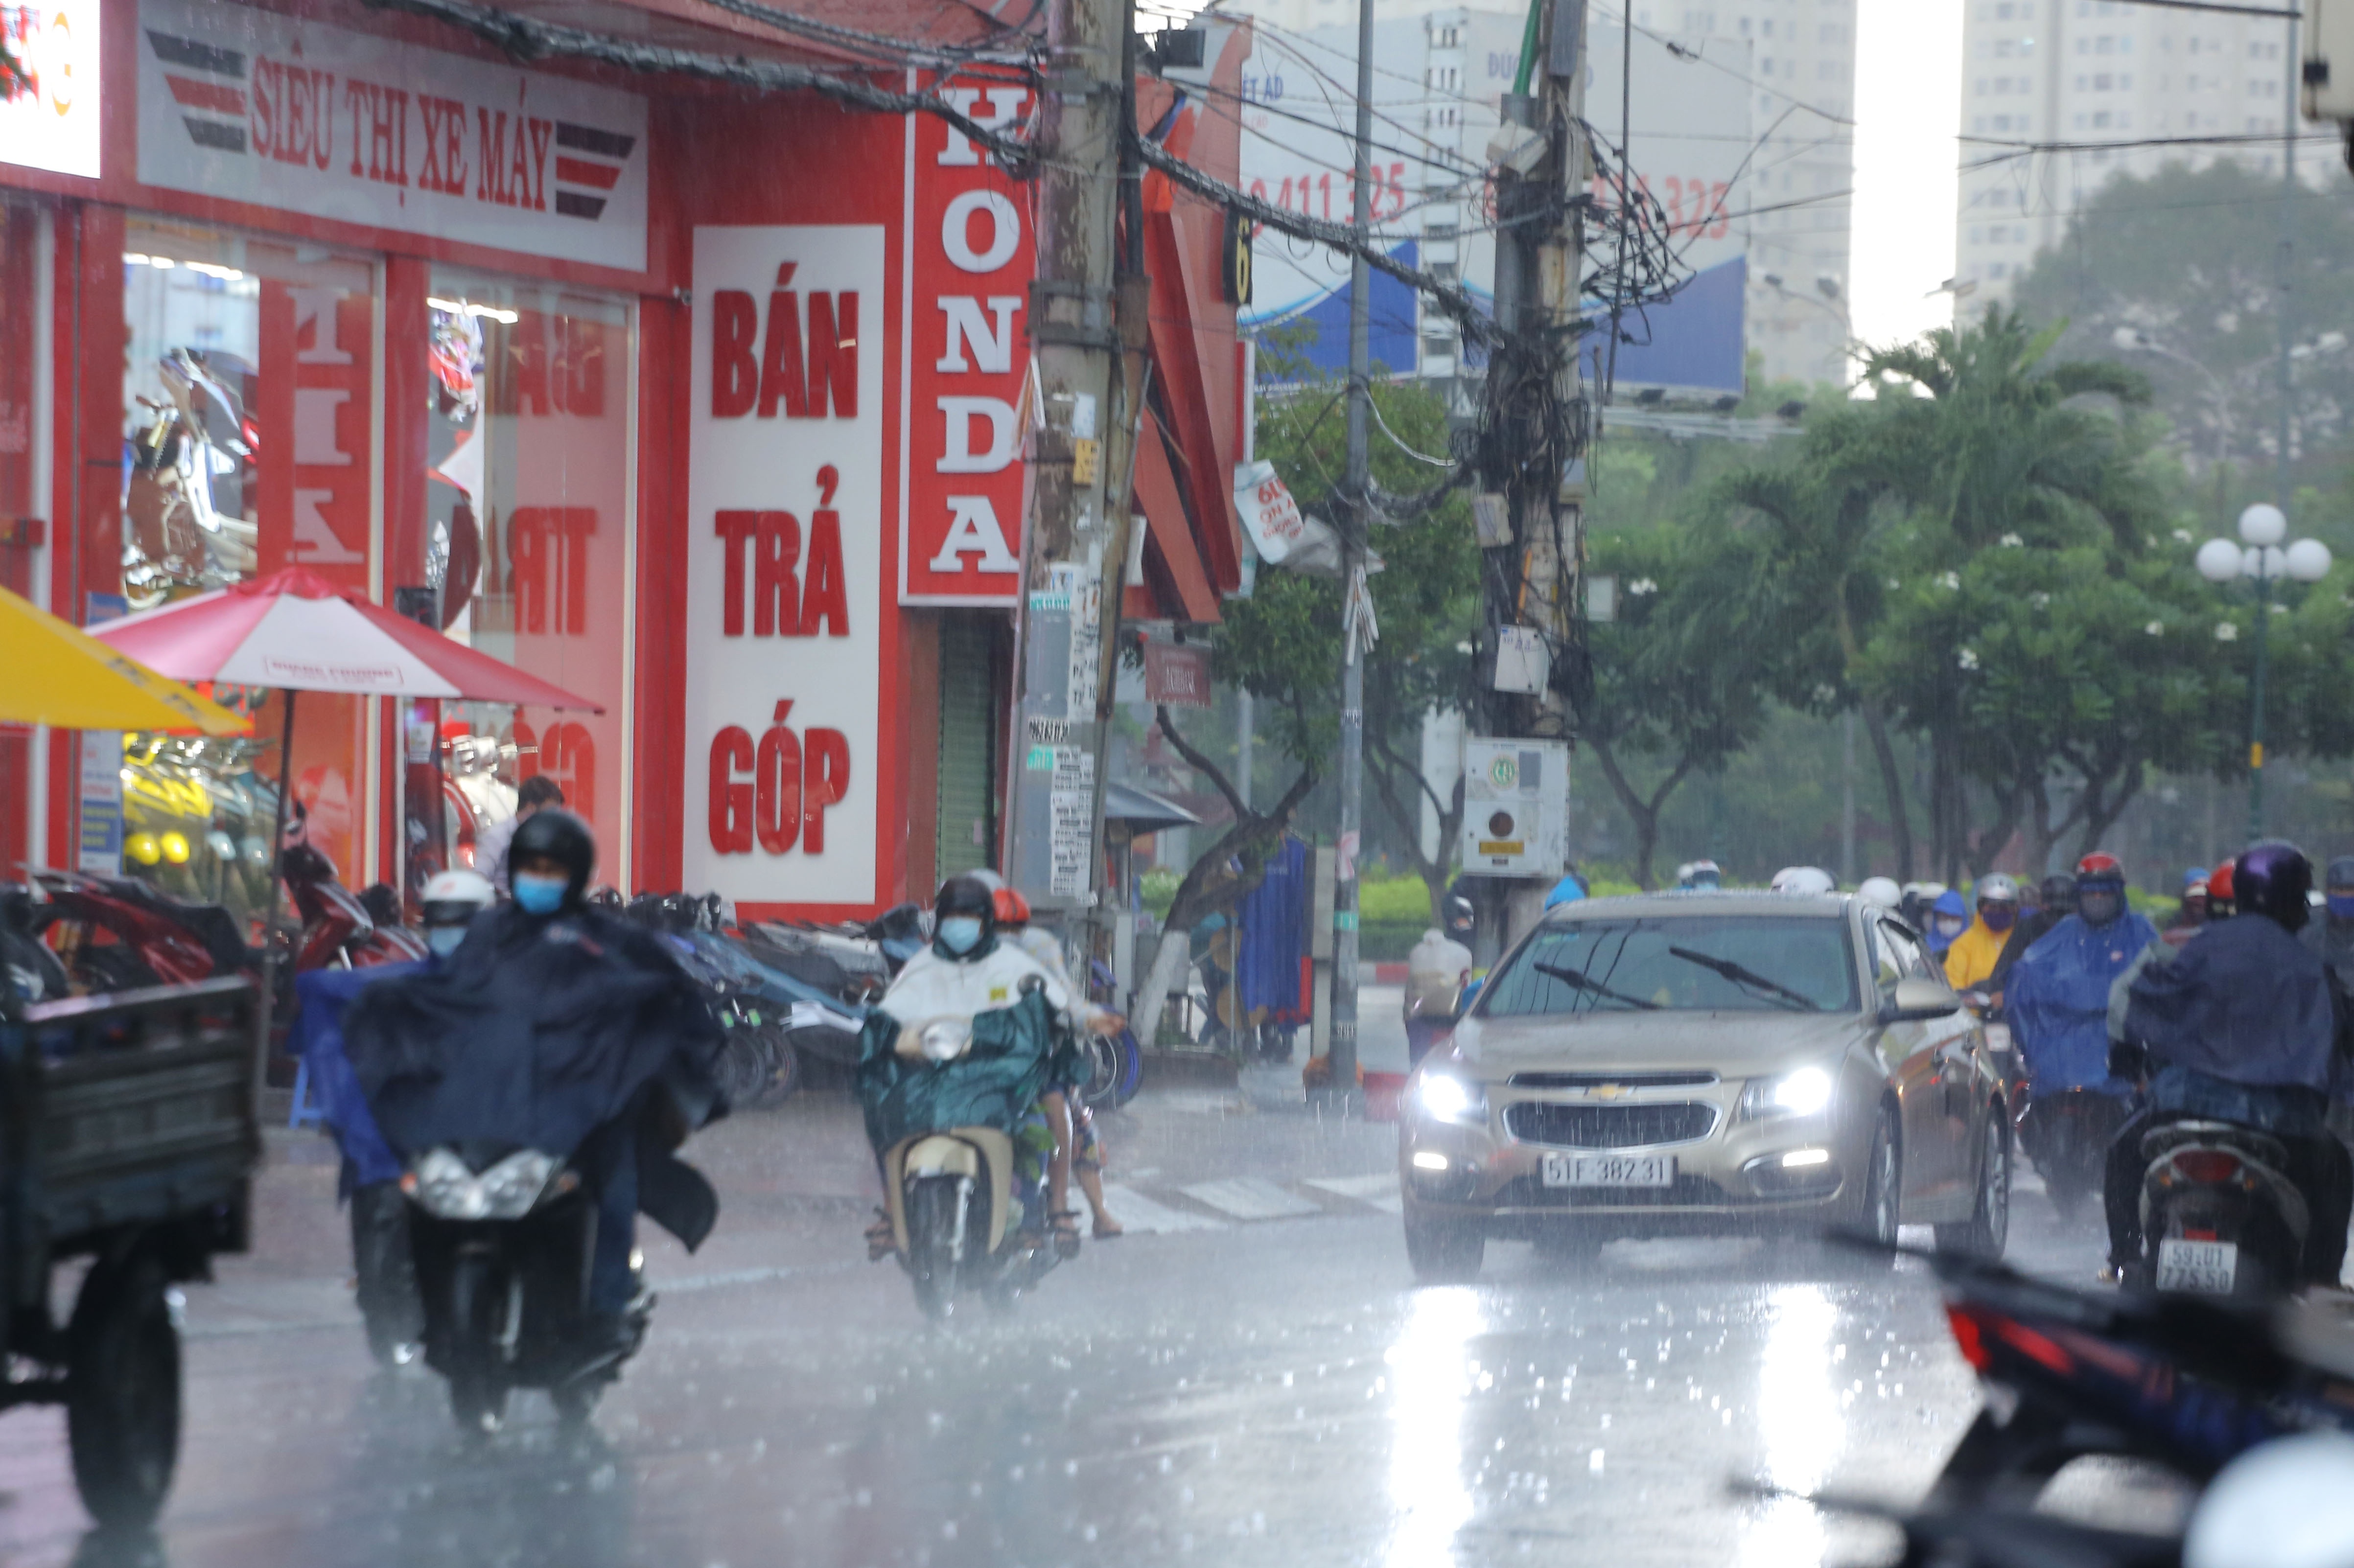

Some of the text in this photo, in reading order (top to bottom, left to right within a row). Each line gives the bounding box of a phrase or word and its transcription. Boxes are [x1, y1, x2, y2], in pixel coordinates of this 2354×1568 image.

[252, 40, 553, 212] SIÊU THỊ XE MÁY
[1665, 174, 1731, 240] 325
[711, 261, 860, 419] BÁN
[930, 88, 1028, 574] HONDA
[715, 463, 851, 638] TRẢ
[708, 699, 851, 856] GÓP
